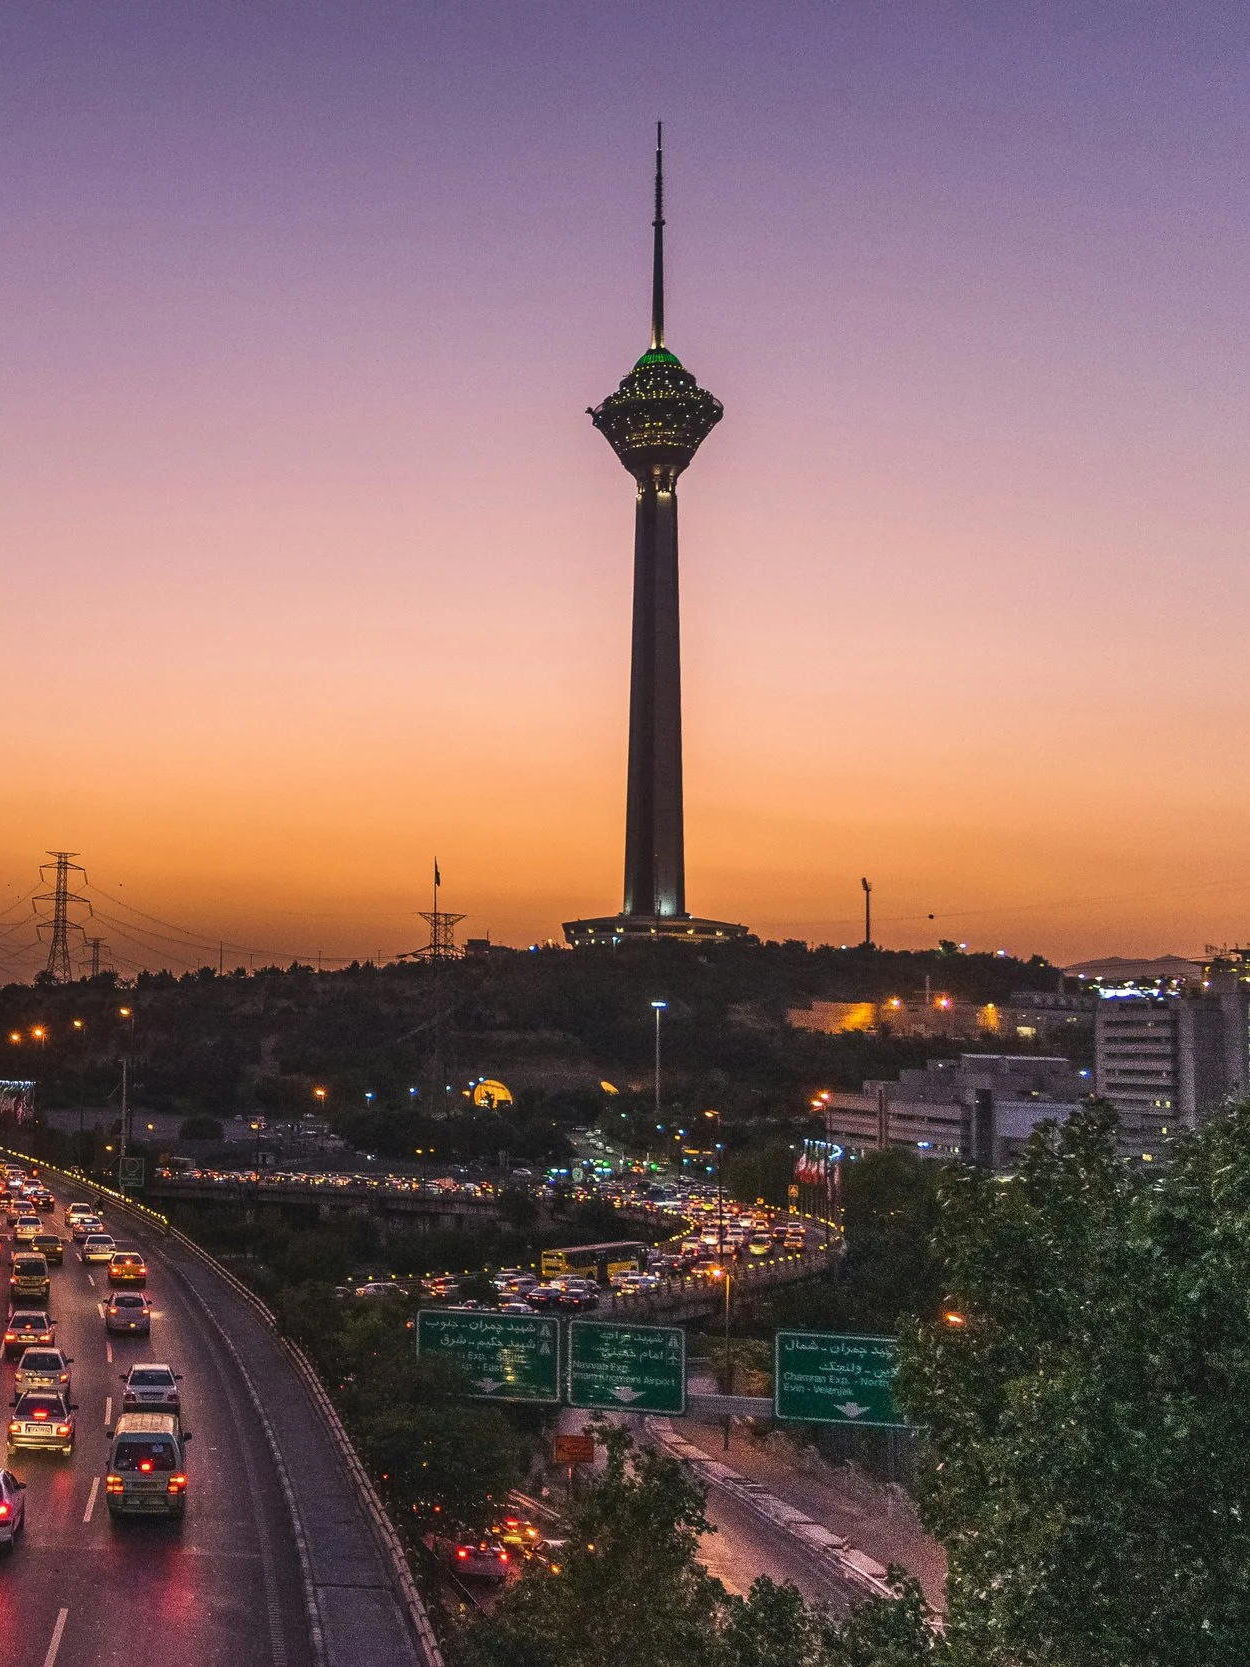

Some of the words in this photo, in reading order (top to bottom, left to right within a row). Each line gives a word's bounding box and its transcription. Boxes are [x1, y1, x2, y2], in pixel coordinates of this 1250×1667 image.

[425, 1320, 459, 1331] جنوب
[469, 1319, 504, 1334] چمران
[507, 1321, 536, 1334] شهید
[440, 1334, 467, 1347] شرق
[476, 1337, 504, 1350] حکیم
[785, 1339, 819, 1351] شمال
[640, 1350, 664, 1362] امام
[830, 1342, 867, 1359] چمران
[643, 1377, 676, 1387] Airport
[784, 1372, 826, 1383] Chamran
[783, 1383, 805, 1393] Evin
